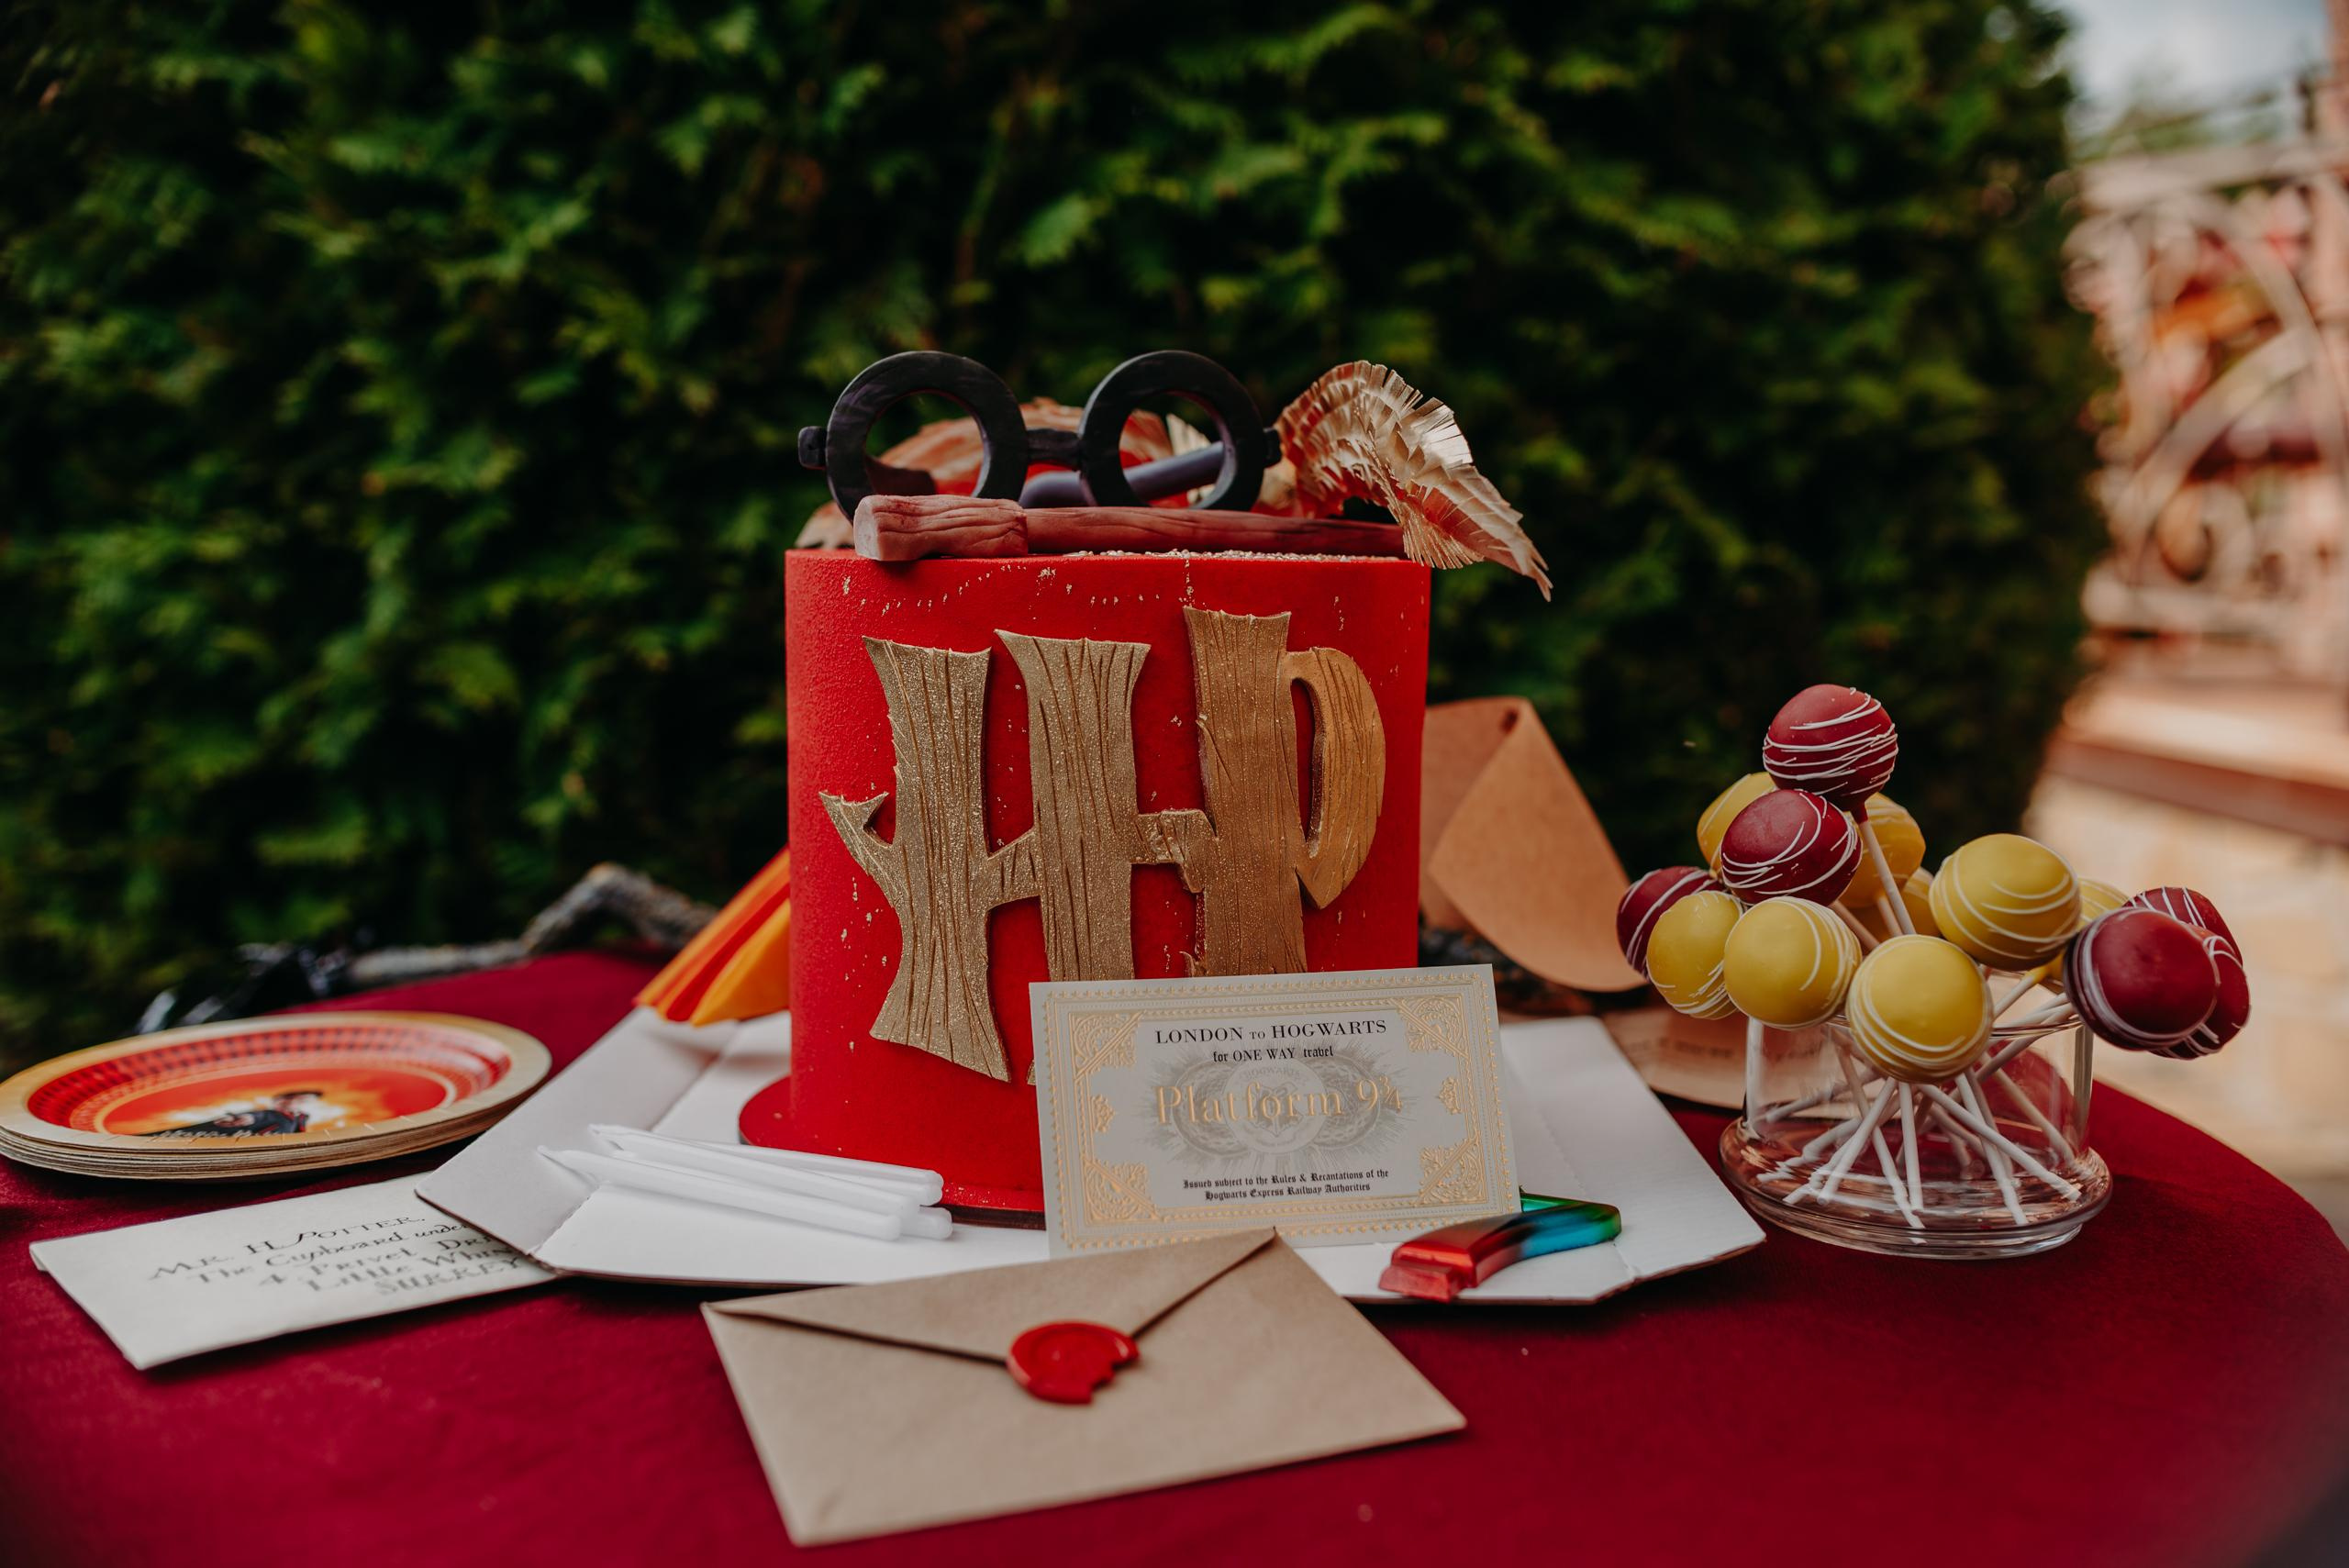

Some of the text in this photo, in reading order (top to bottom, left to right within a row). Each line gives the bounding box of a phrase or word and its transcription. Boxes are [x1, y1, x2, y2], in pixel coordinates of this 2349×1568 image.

[1155, 1027, 1243, 1044] LONDON
[1271, 1019, 1386, 1039] HOGWARTS
[1213, 1045, 1333, 1062] for ONE WAY travel
[1155, 1082, 1344, 1126] Platform
[1183, 1179, 1211, 1189] Issued
[1215, 1177, 1242, 1187] subject
[1256, 1175, 1268, 1185] the
[1272, 1174, 1297, 1184] Rules
[1299, 1173, 1307, 1183] &
[1365, 1169, 1375, 1179] of
[1376, 1169, 1389, 1179] the
[1205, 1183, 1371, 1201] Hogwarts Express Railway Authorities
